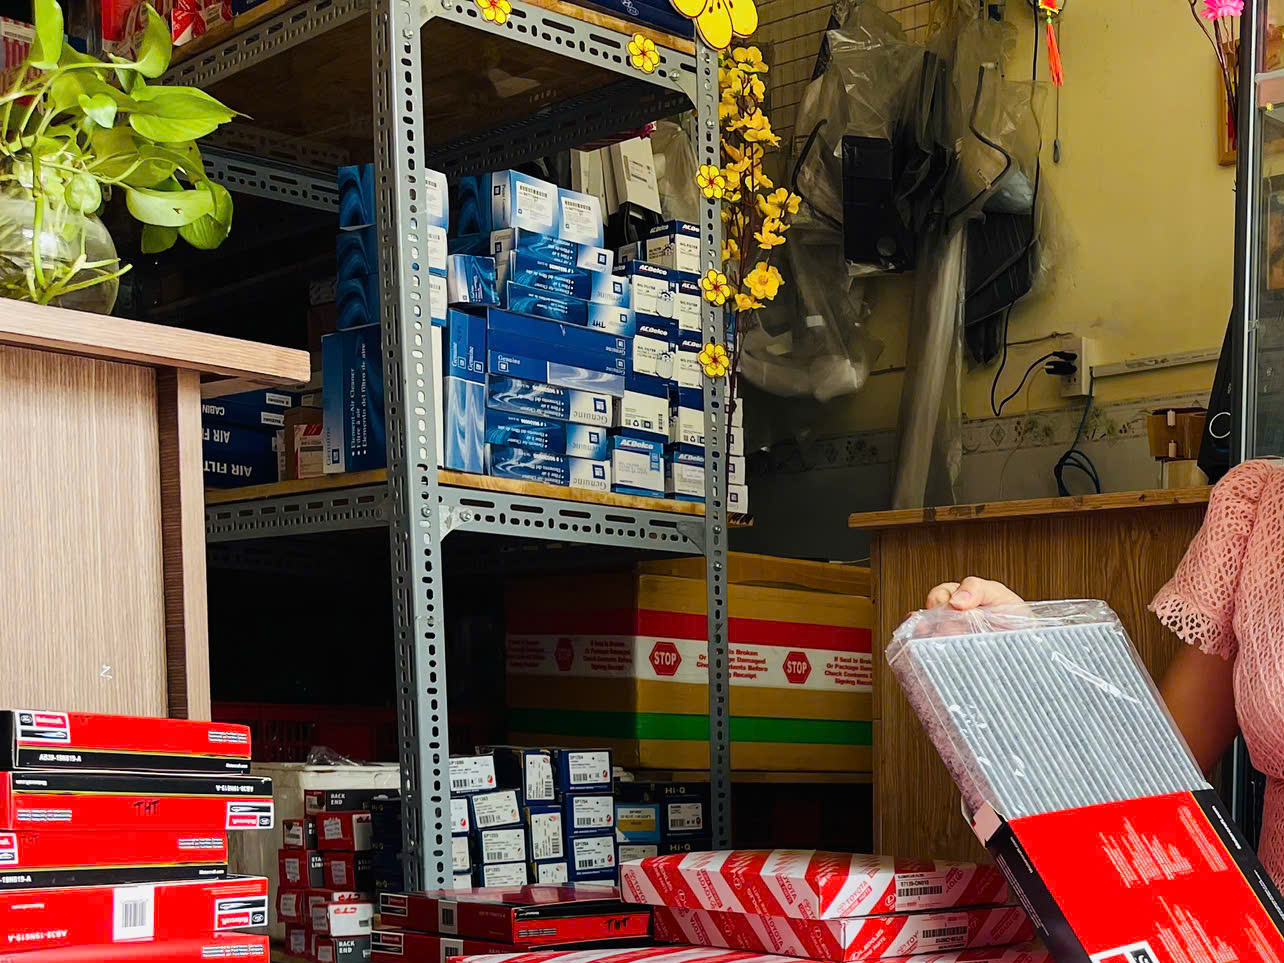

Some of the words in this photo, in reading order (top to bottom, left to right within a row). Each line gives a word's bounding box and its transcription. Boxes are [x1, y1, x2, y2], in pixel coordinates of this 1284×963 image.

[638, 264, 668, 275] ACDelco
[640, 325, 668, 336] ACDelco
[213, 429, 231, 444] AIR
[621, 438, 654, 450] ACDelco
[232, 464, 252, 477] AIR
[654, 652, 677, 666] STOP
[787, 661, 808, 675] STOP
